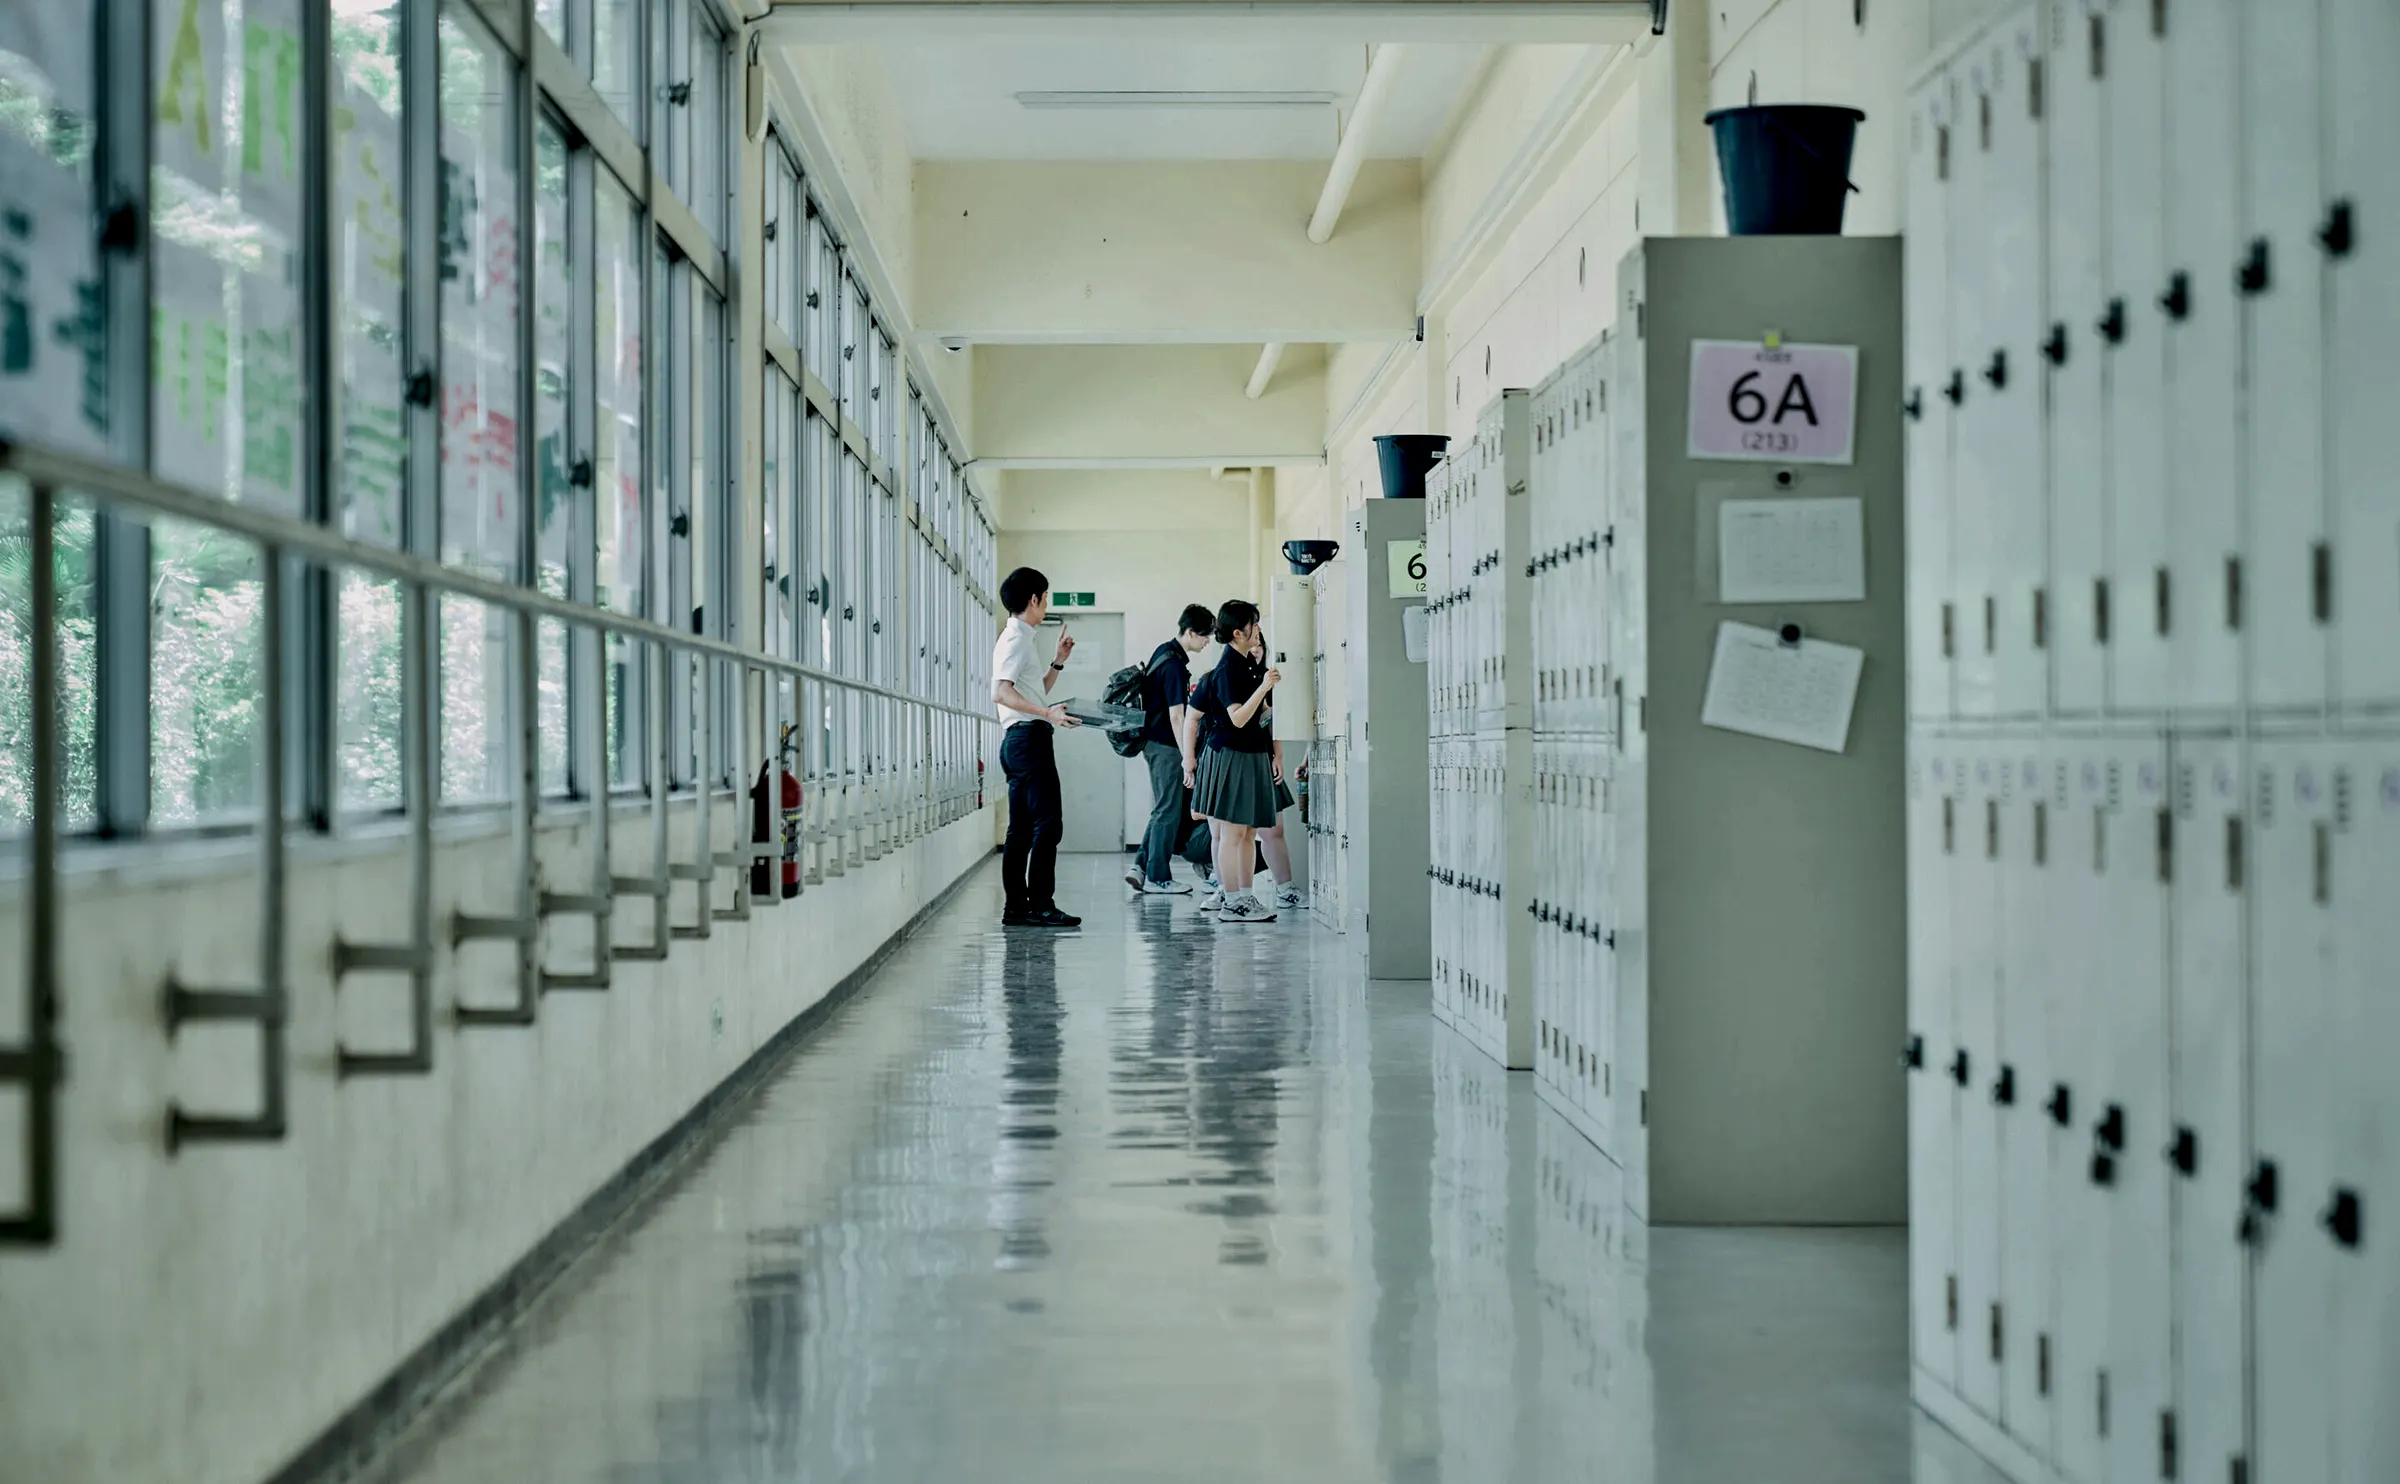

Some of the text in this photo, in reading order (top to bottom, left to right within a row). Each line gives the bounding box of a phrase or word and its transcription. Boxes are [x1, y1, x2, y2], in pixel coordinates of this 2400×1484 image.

[1729, 370, 1819, 426] 6A
[1741, 432, 1799, 452] (213)
[1408, 553, 1427, 580] 6
